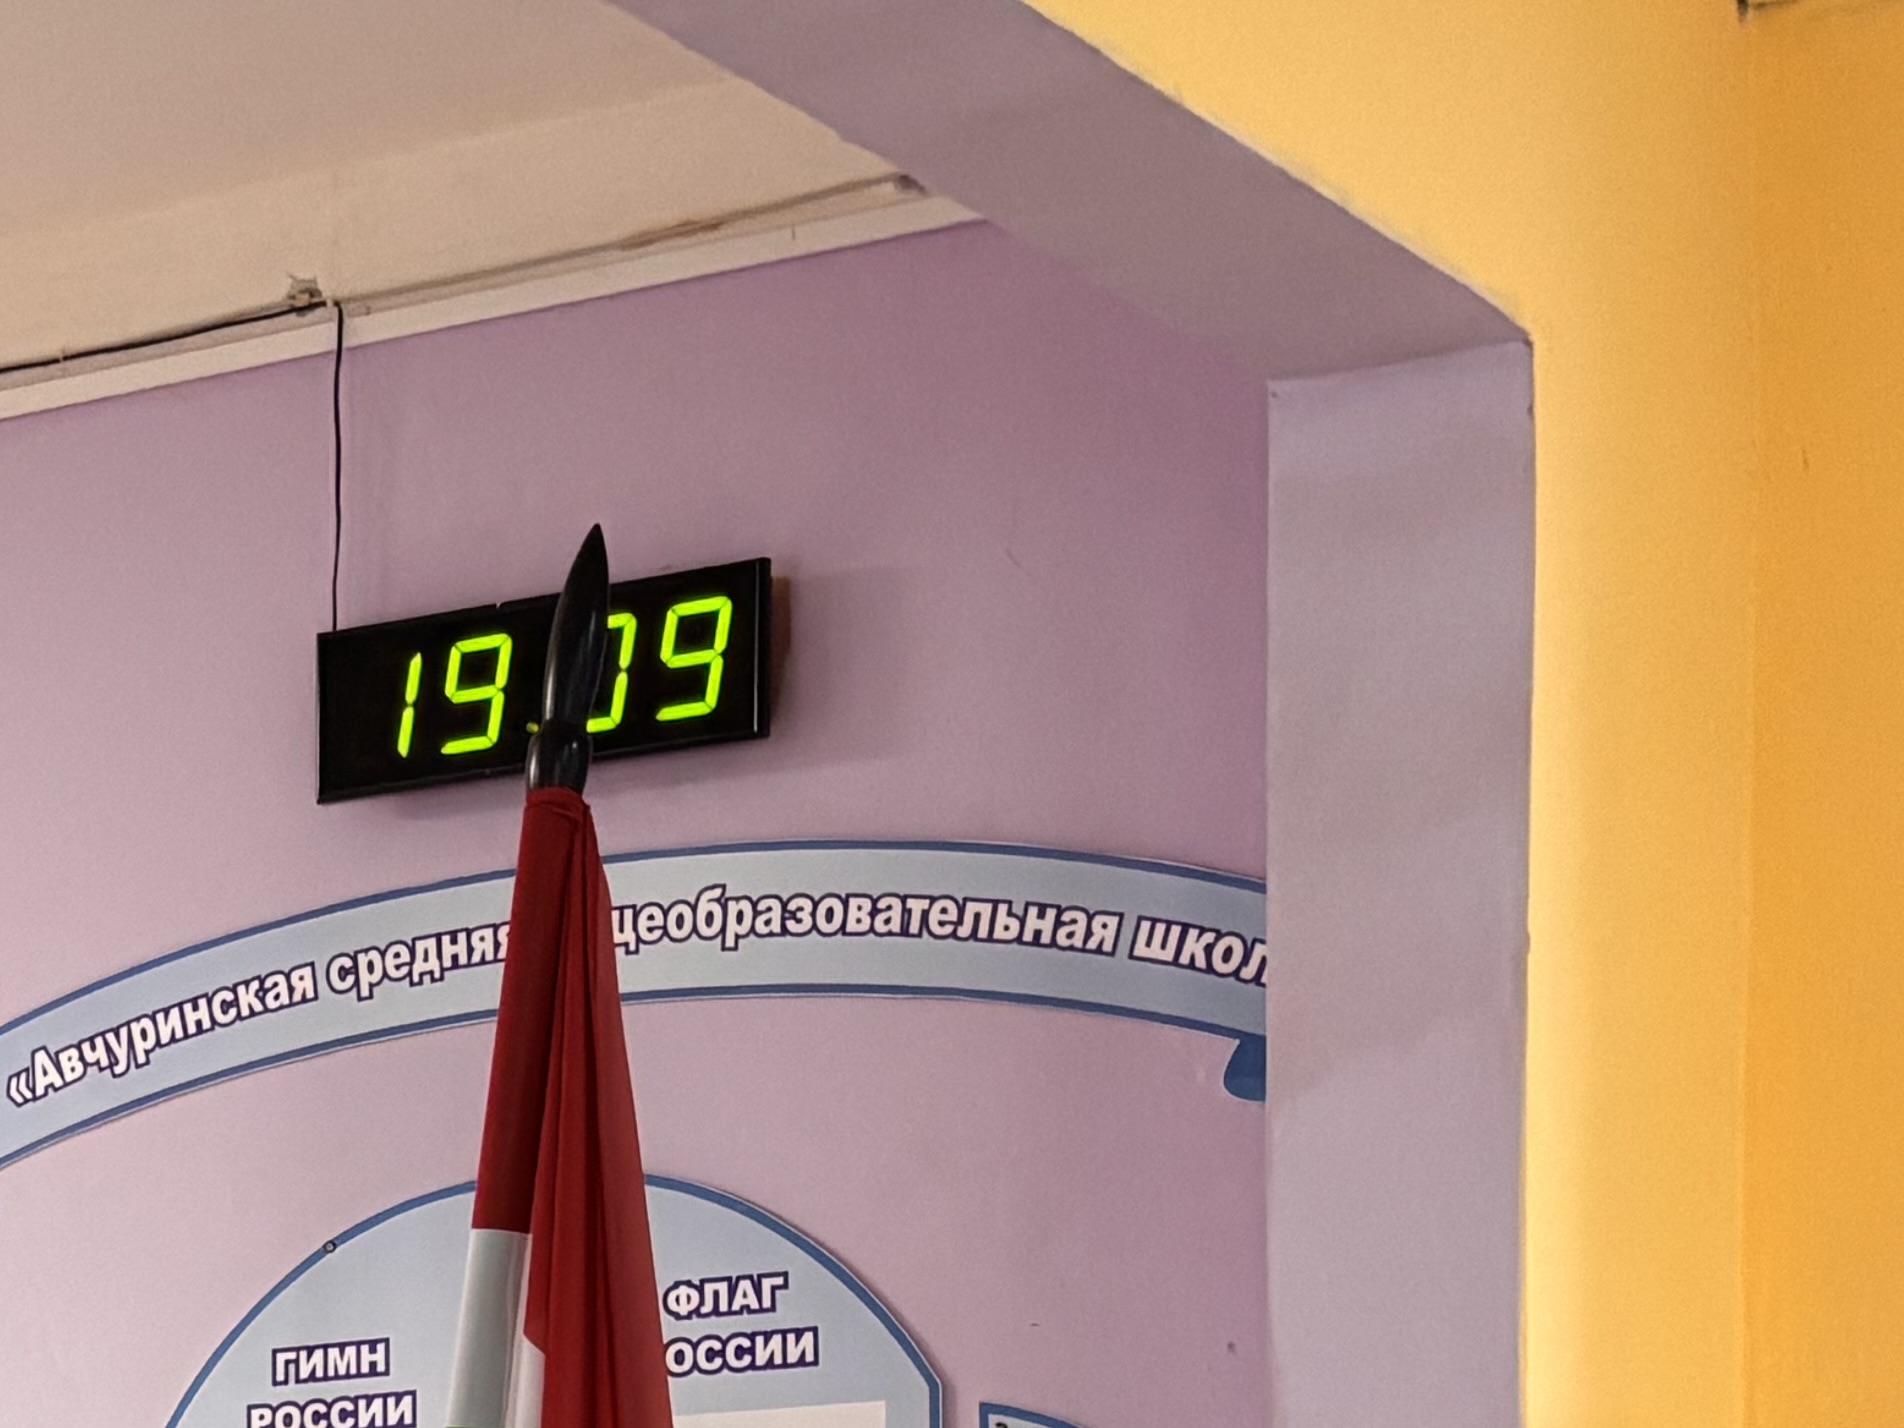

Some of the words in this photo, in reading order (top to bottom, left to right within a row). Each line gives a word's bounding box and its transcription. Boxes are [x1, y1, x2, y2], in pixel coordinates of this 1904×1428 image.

[7, 962, 317, 1108] «Авчуринская
[611, 882, 1124, 957] щеобразовательная
[1128, 914, 1266, 989] школ
[662, 1270, 789, 1321] ФЛАГ
[271, 1336, 390, 1387] ГИМН
[665, 1326, 819, 1378] ОССИИ
